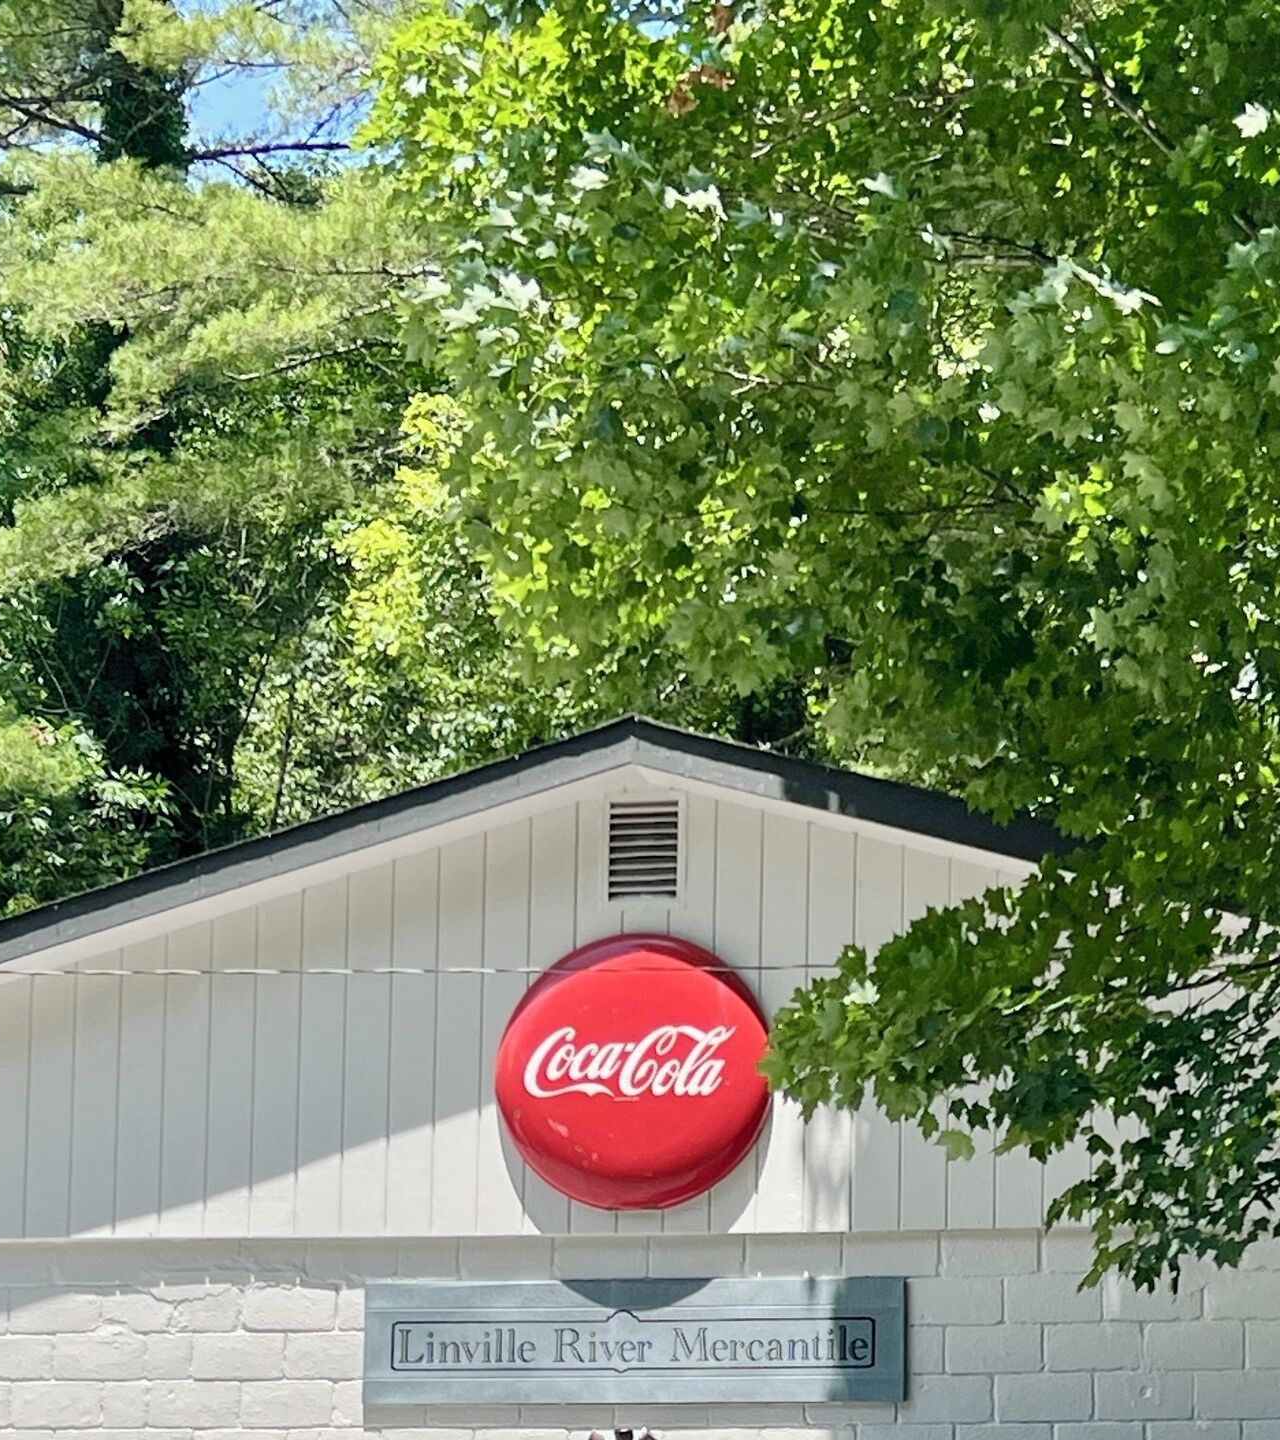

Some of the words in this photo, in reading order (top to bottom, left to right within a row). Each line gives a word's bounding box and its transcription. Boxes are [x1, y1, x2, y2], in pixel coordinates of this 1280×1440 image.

[523, 1025, 736, 1099] Coca-Cola
[396, 1326, 536, 1365] Linville
[552, 1325, 652, 1364] River
[669, 1323, 870, 1363] Mercantile
